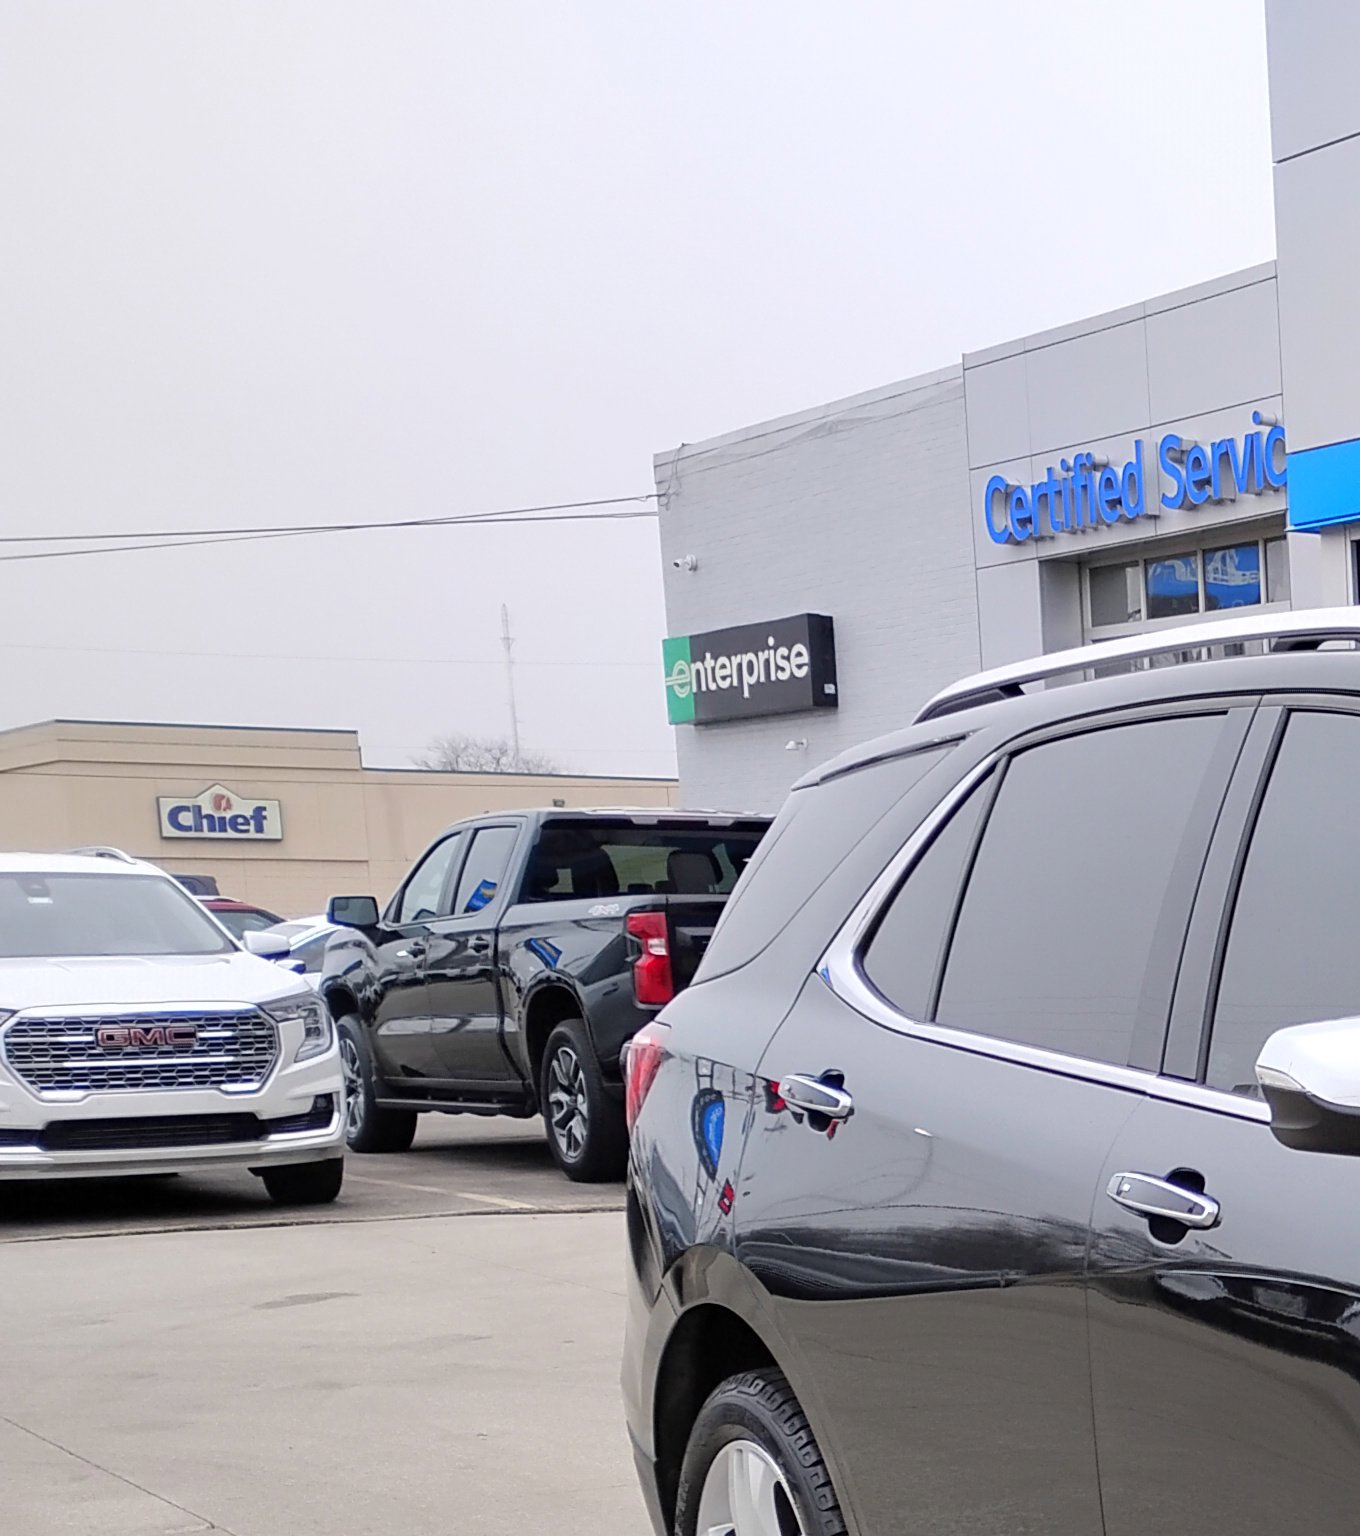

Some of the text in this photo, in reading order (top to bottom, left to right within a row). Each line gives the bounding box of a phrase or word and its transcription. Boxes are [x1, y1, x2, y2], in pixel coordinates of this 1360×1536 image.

[985, 438, 1146, 545] Certified
[665, 636, 810, 699] enterprise
[166, 804, 268, 834] Chief
[96, 1027, 198, 1047] GMC
